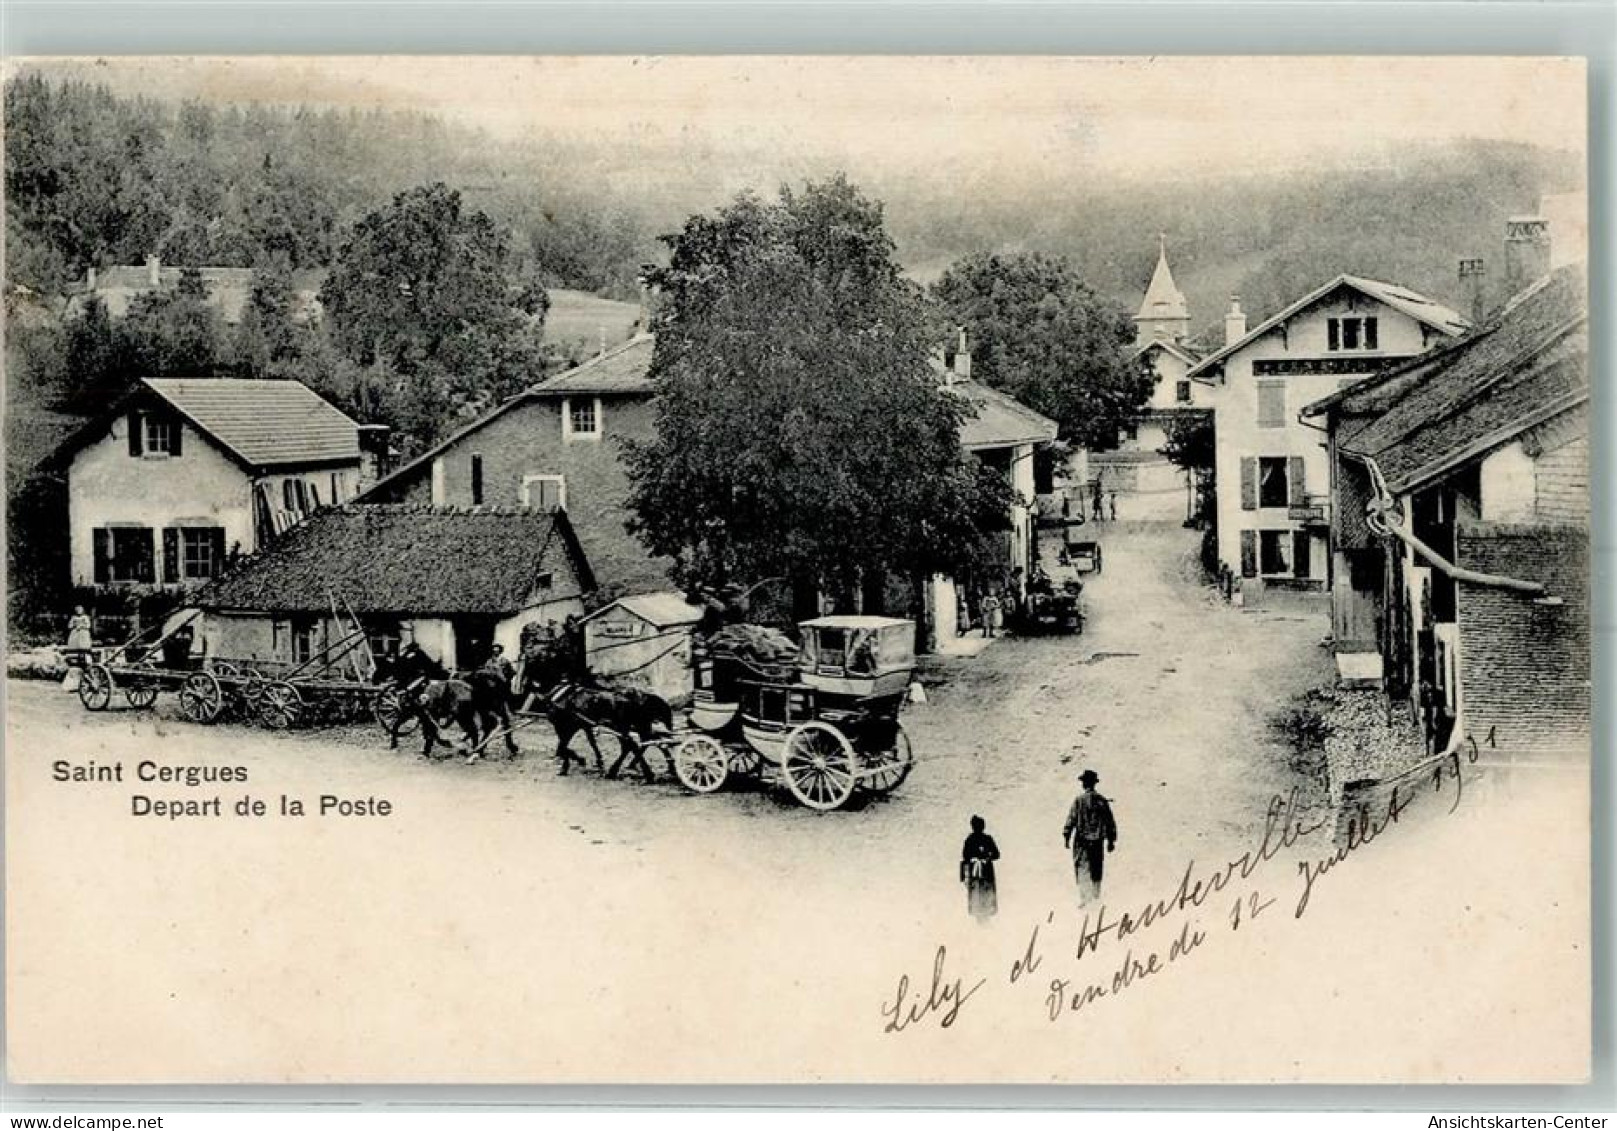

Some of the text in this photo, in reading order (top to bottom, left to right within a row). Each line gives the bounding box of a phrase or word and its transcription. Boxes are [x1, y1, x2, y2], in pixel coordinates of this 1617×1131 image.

[52, 760, 249, 787] Saint Cergues
[131, 794, 393, 821] Depart de la Poste
[1229, 891, 1277, 931] 12
[881, 944, 987, 1033] Lily
